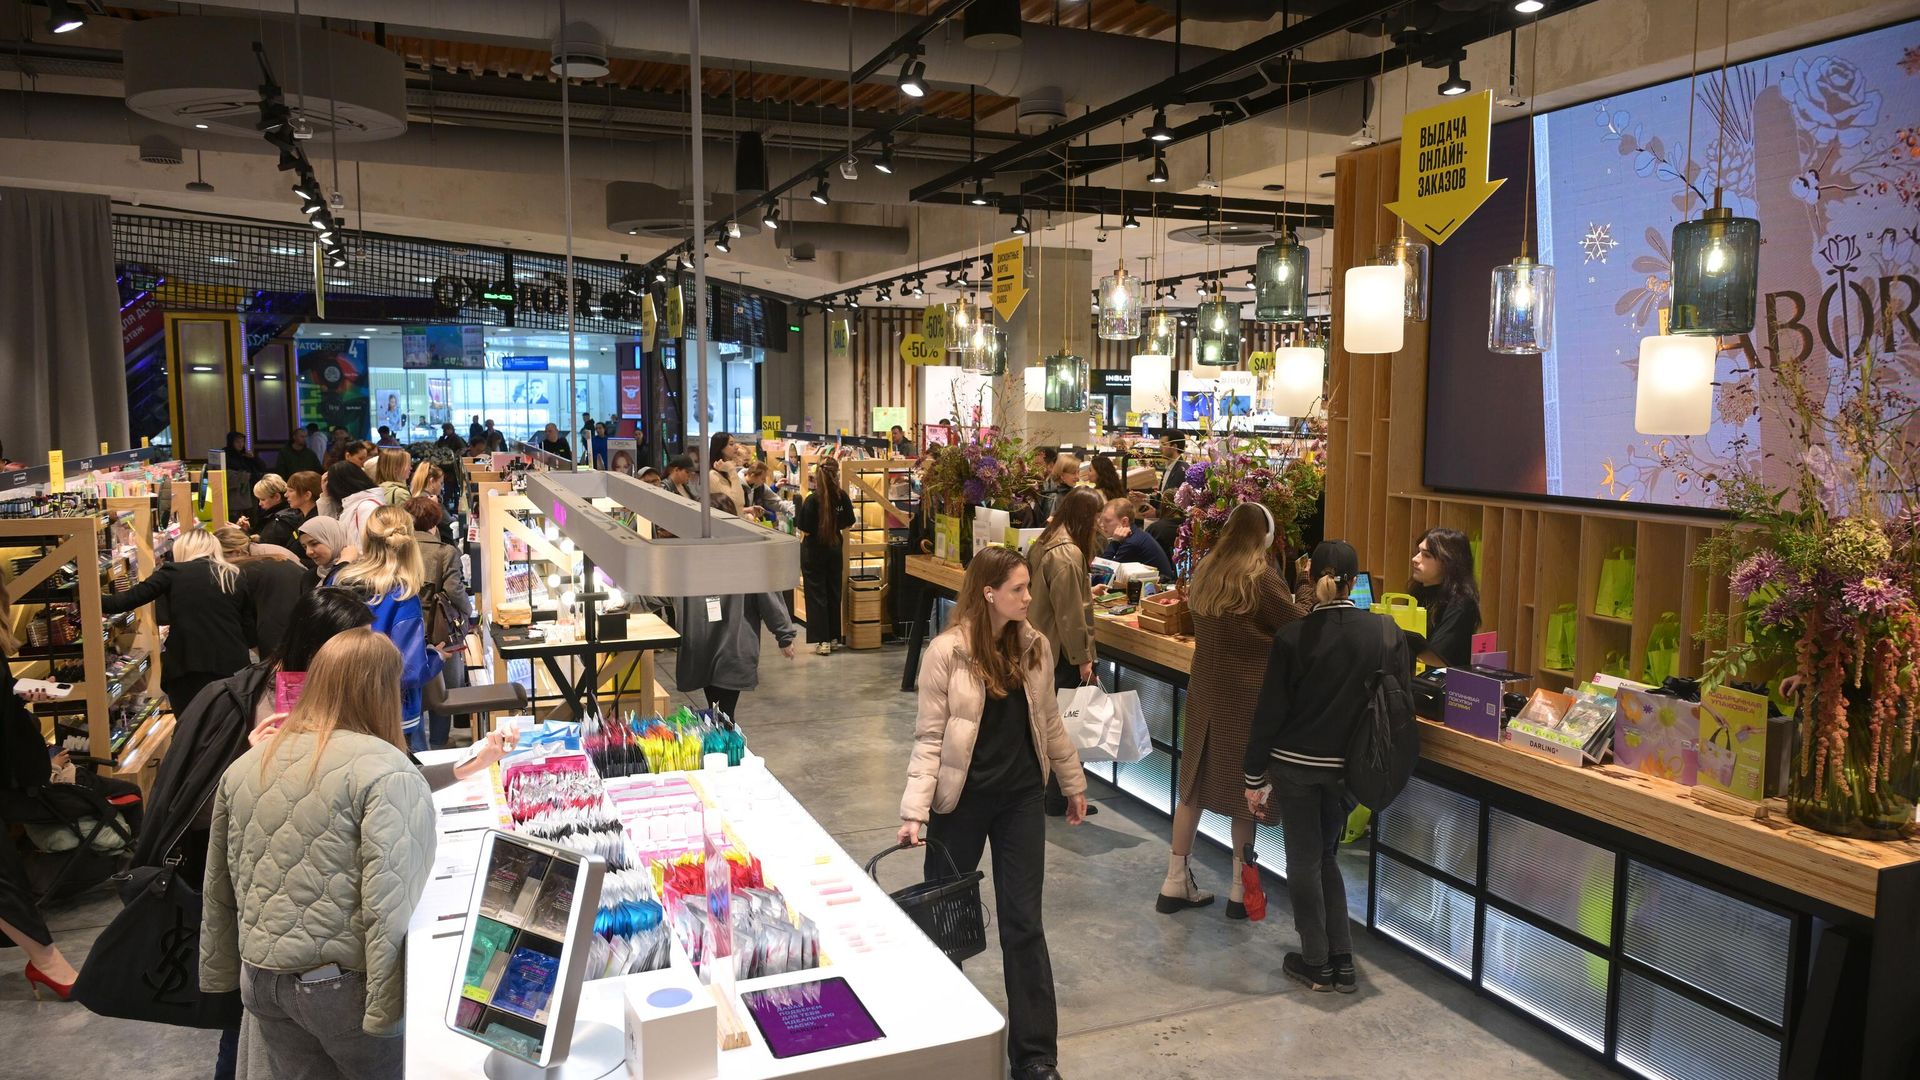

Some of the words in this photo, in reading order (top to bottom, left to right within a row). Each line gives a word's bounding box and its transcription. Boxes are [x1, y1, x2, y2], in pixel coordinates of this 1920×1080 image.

[1420, 115, 1467, 149] ВЫДАЧА
[1418, 141, 1468, 173] ОНЛАЙН-
[1417, 167, 1467, 198] ЗАКАЗОВ
[926, 314, 944, 339] -50%
[349, 339, 358, 358] 4
[907, 341, 939, 358] -50%
[763, 420, 780, 431] SALE
[1711, 699, 1756, 714] УПАКОВКА
